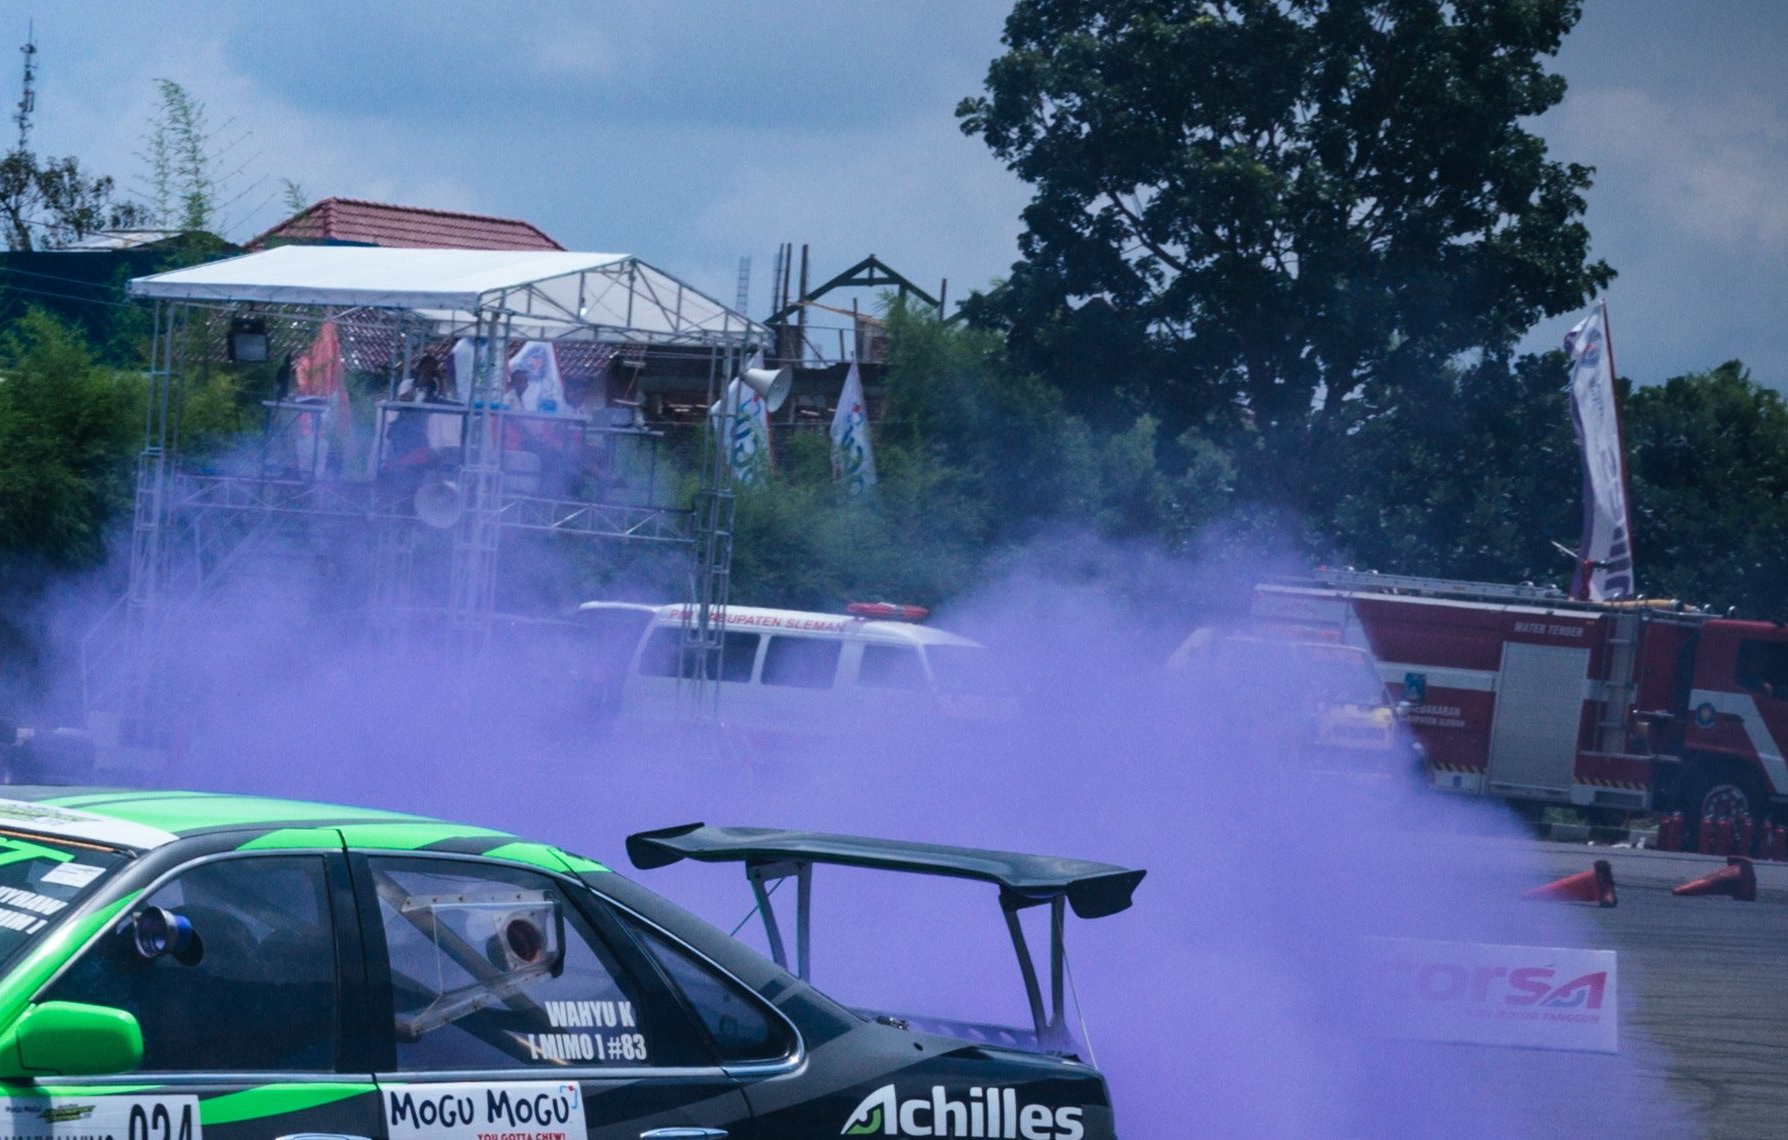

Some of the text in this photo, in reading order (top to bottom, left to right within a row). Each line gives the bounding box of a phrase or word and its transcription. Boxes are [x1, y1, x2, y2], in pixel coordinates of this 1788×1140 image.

[785, 618, 844, 632] SLEMAN
[545, 1001, 636, 1028] WAHYU K
[606, 1033, 647, 1061] #83
[390, 1089, 570, 1130] MOGU MOGU
